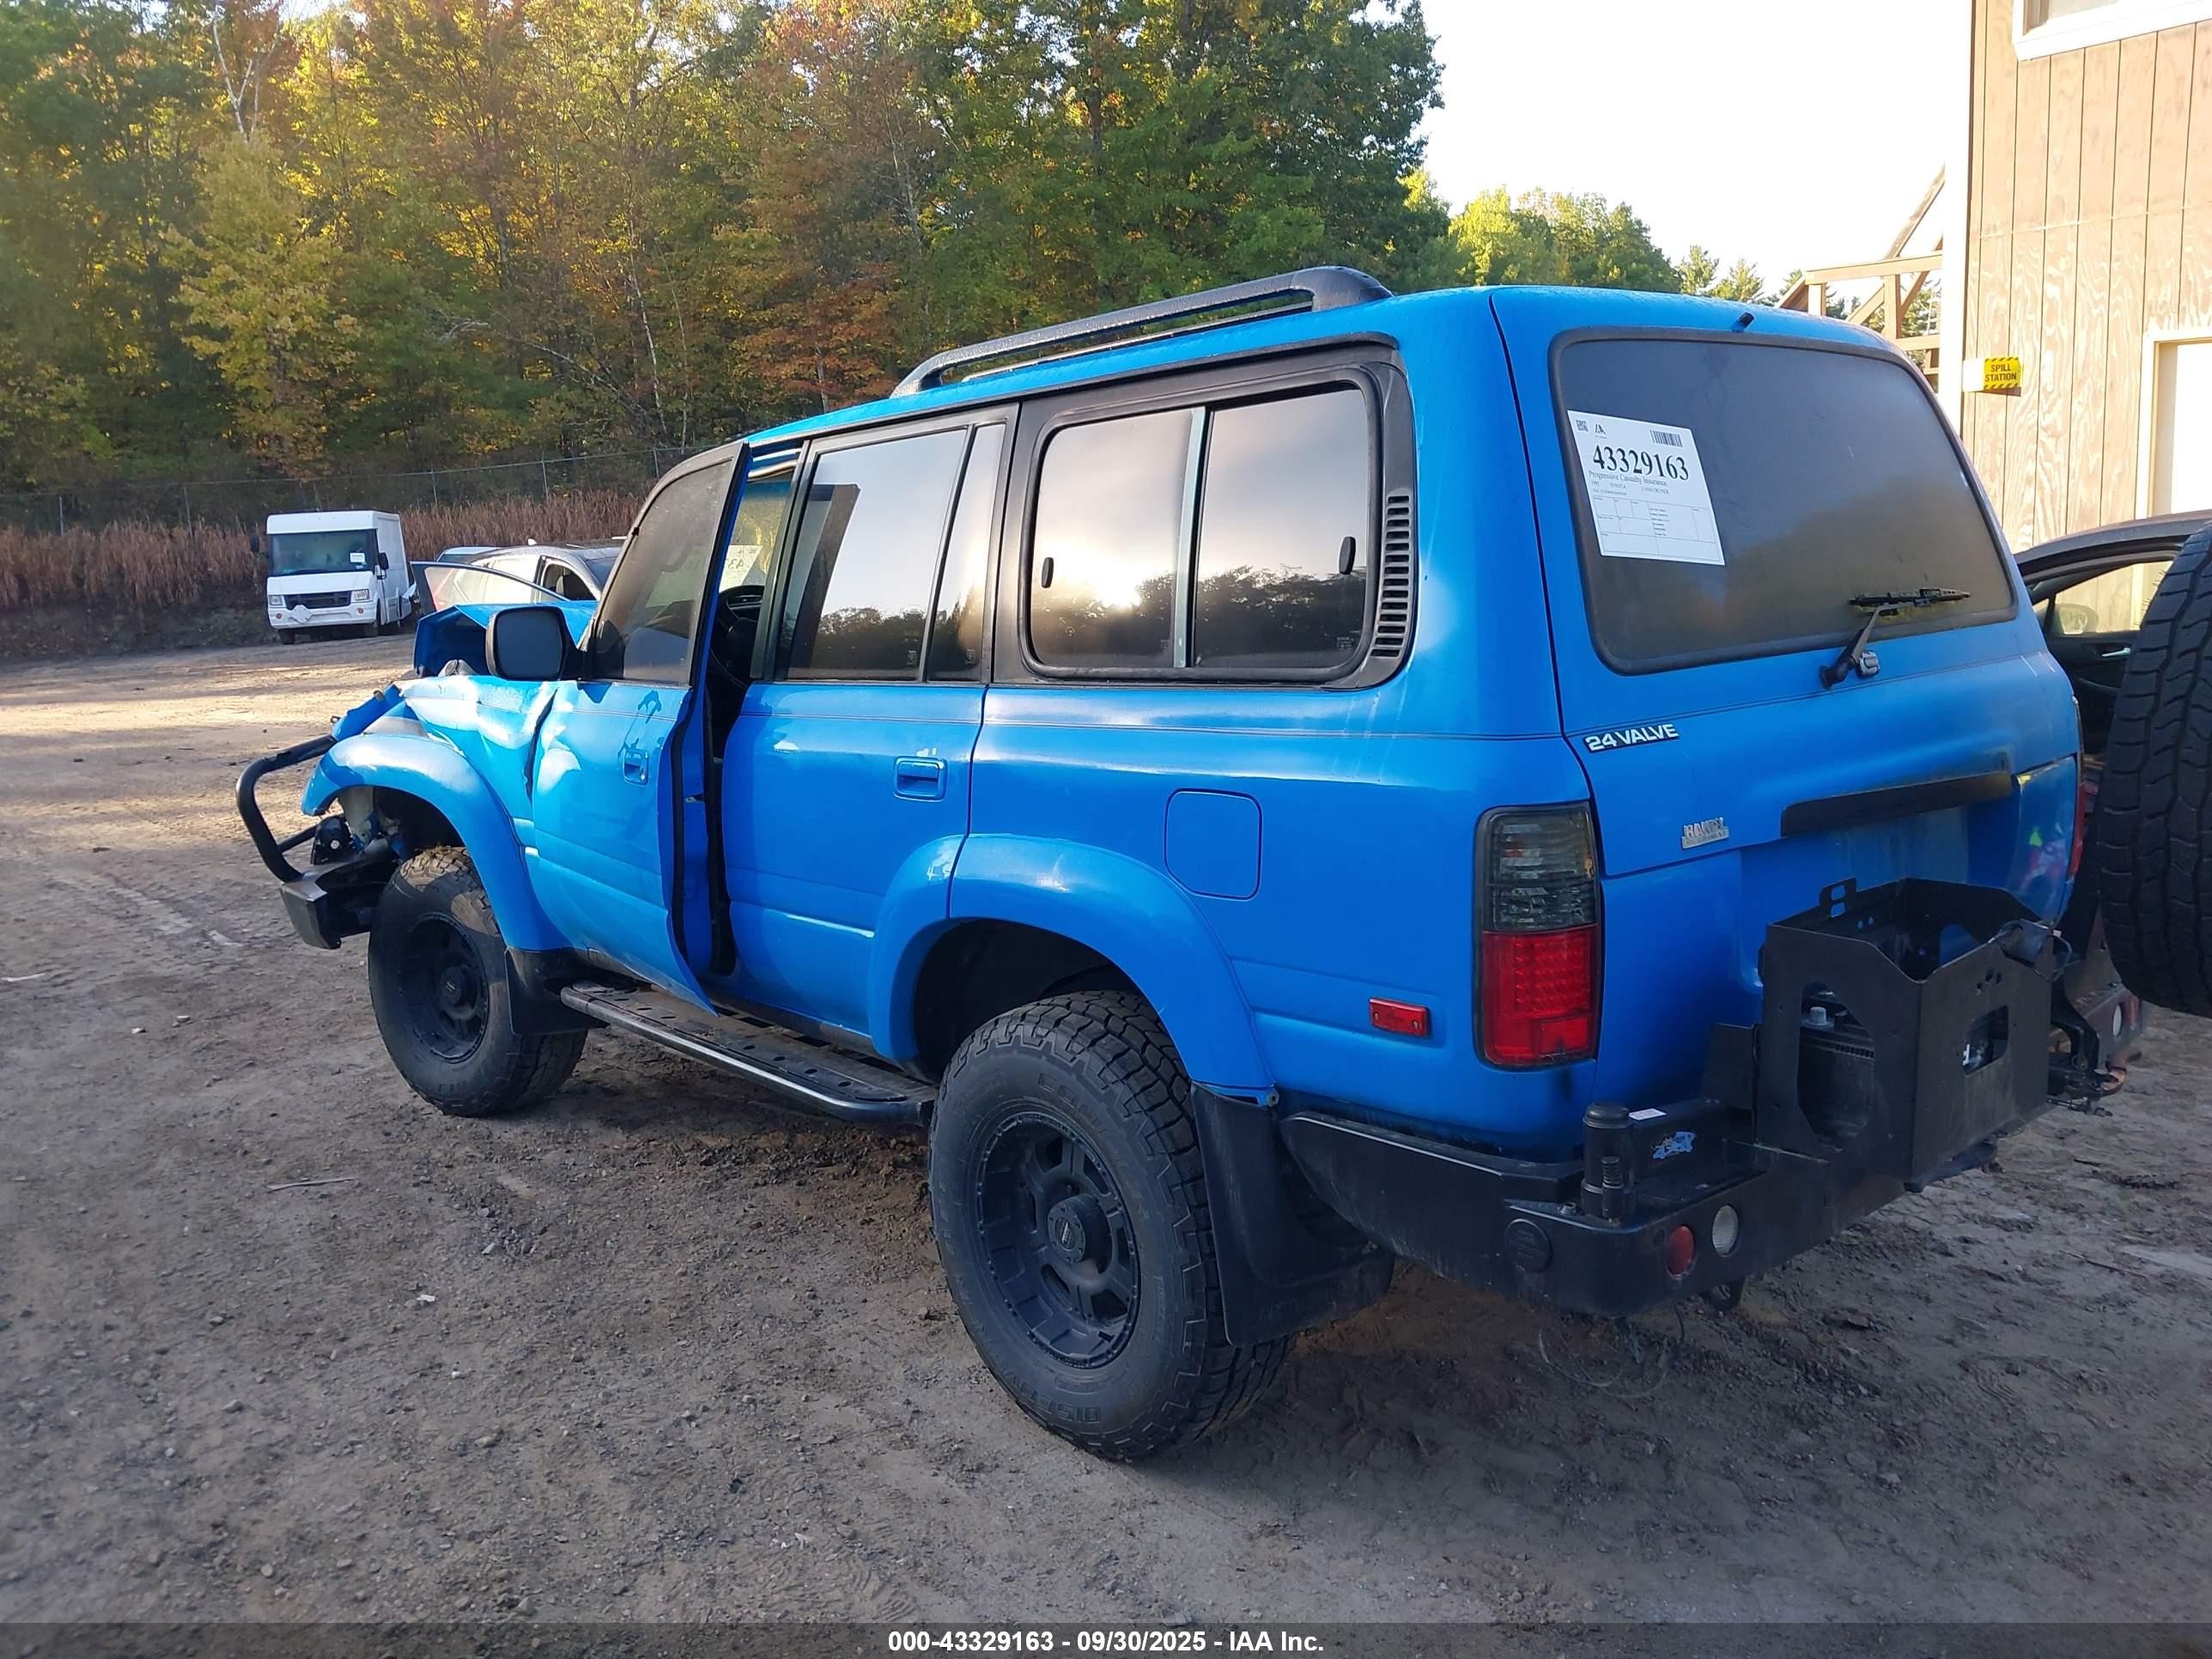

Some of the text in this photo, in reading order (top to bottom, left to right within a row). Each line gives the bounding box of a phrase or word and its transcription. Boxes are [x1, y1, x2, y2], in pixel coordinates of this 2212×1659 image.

[1990, 363, 2011, 372] SPILL
[1984, 373, 2017, 382] STATION
[1593, 444, 1689, 481] 43329163
[1589, 470, 1668, 486] Progressive Casualty Insurance
[1585, 723, 1680, 751] 24 VALVE
